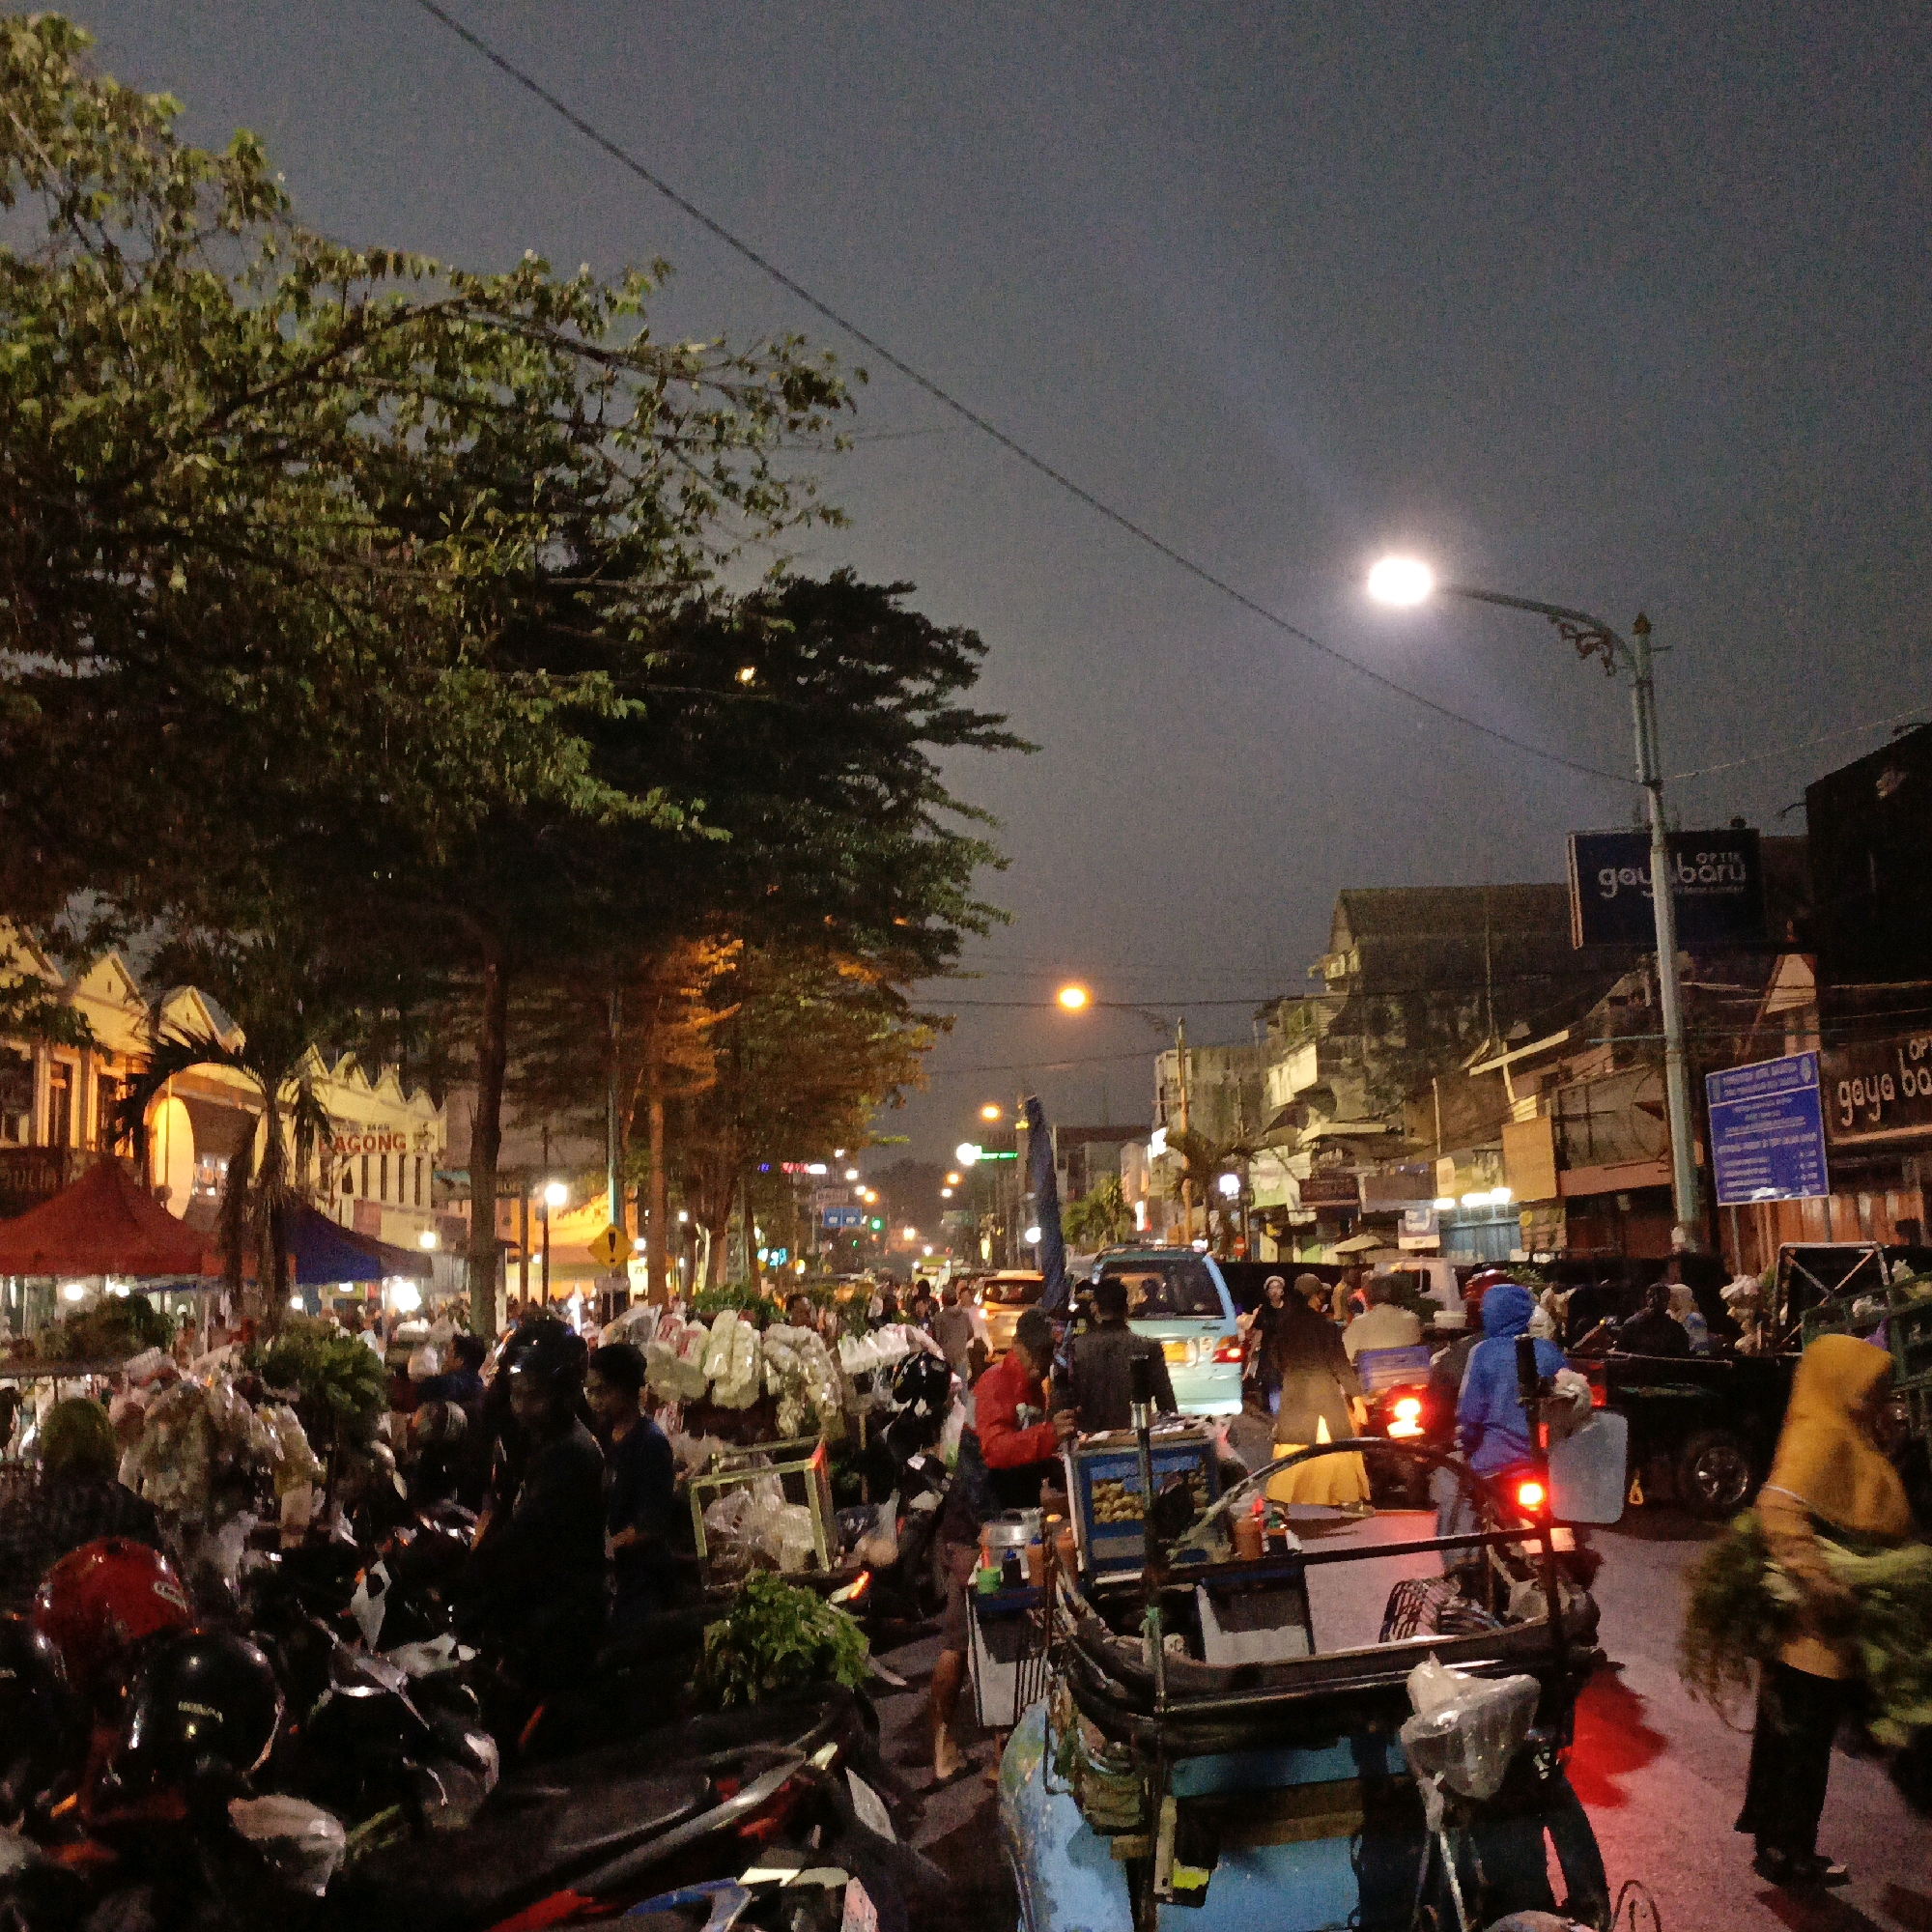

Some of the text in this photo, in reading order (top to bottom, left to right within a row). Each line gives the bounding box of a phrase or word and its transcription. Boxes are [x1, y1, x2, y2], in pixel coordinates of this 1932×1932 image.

[1599, 852, 1747, 898] gay baru
[1909, 1038, 1932, 1061] OP
[1837, 1073, 1894, 1127] gaya
